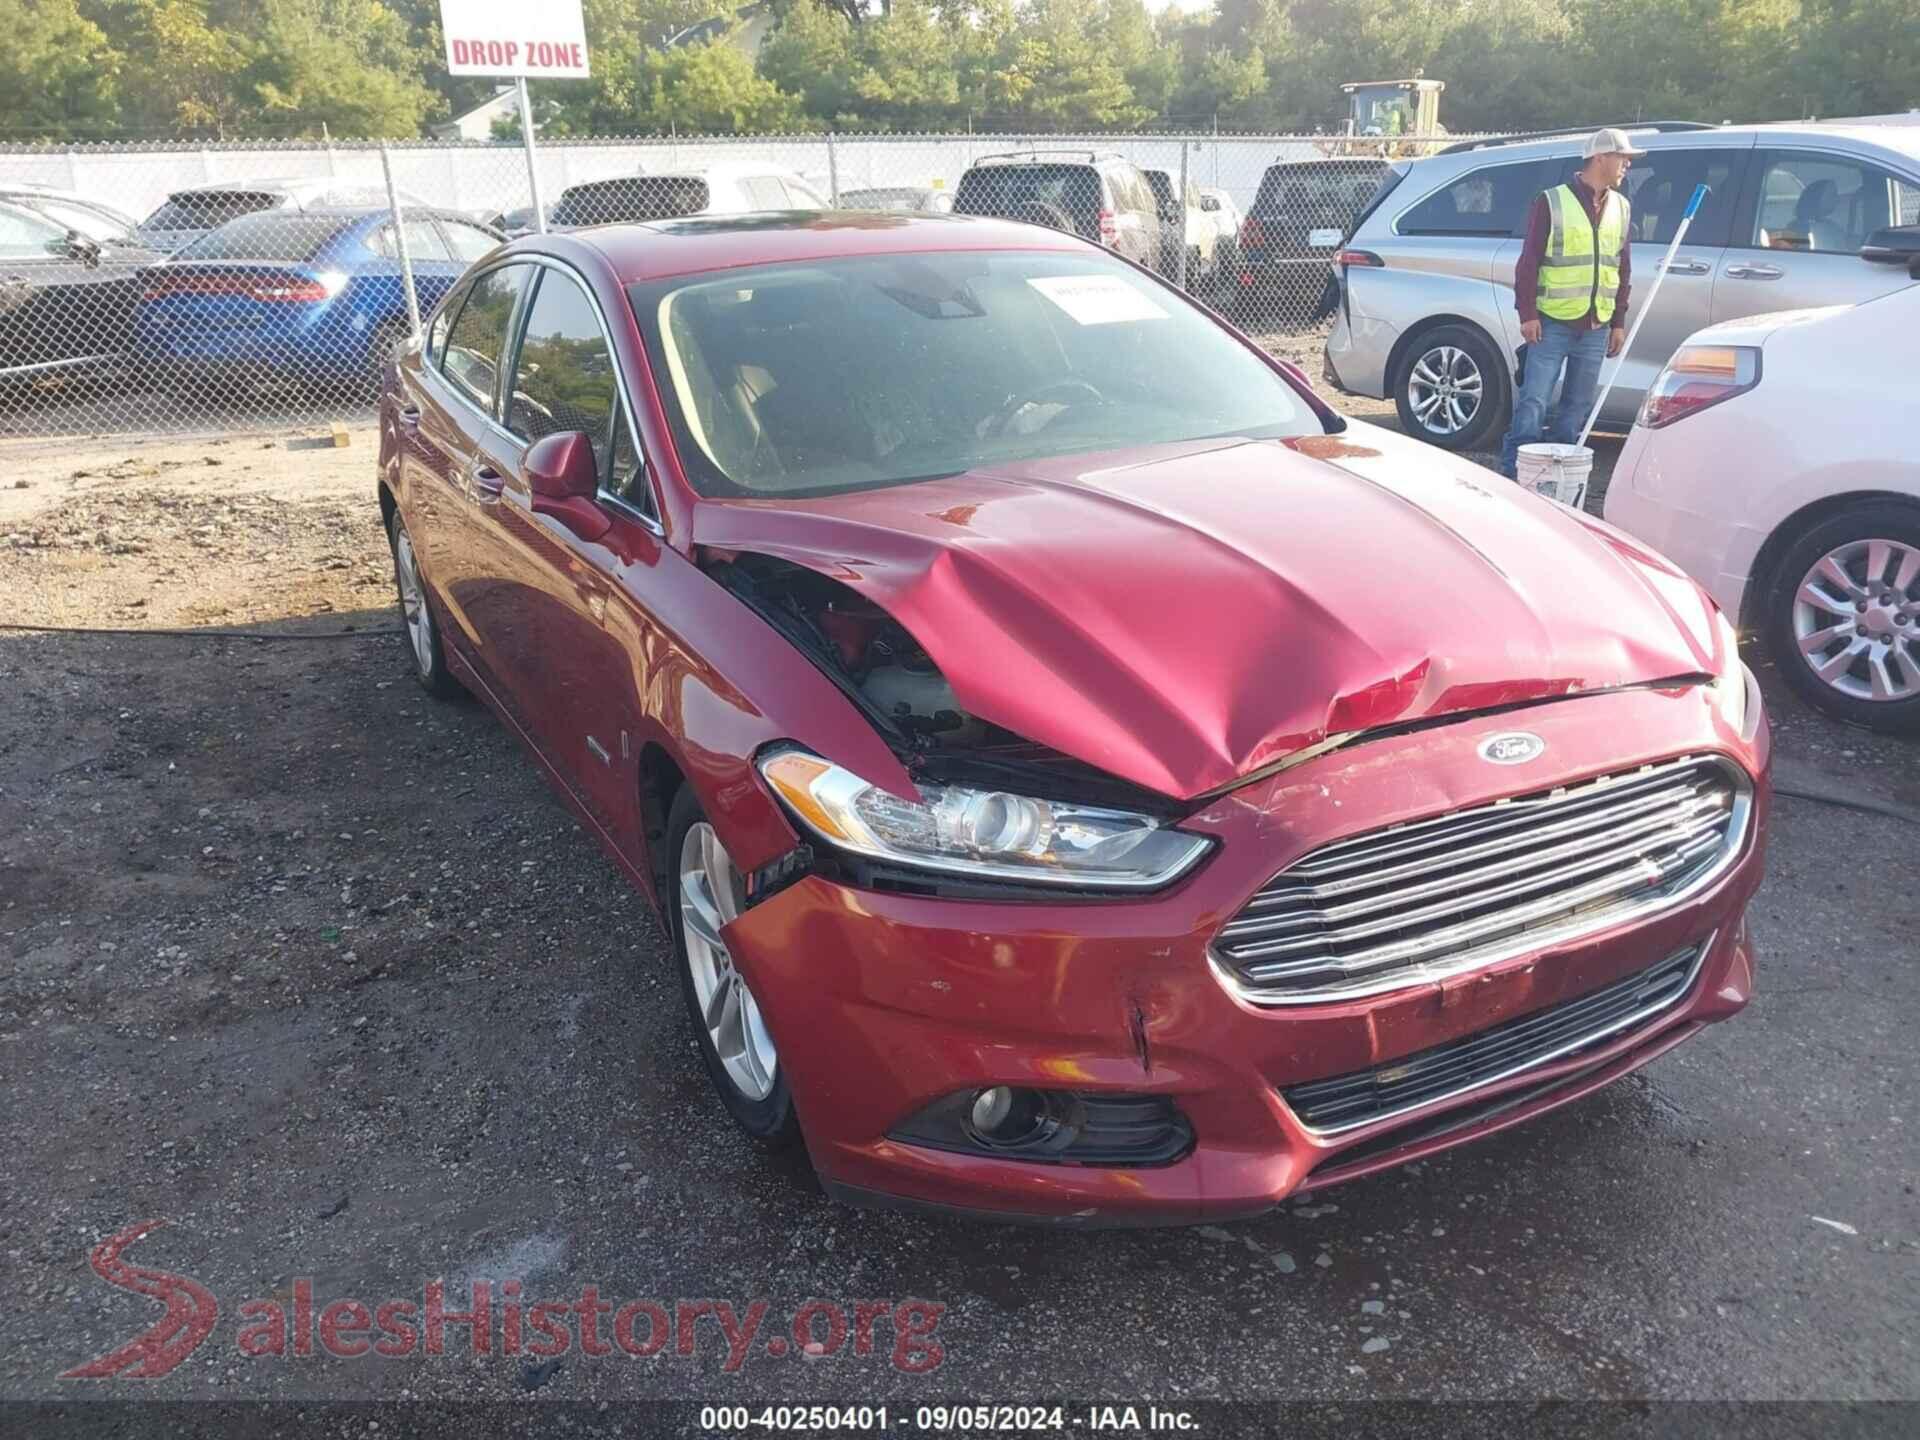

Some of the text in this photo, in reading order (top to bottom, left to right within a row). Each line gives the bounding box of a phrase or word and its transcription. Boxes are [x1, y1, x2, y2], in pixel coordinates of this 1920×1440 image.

[452, 39, 583, 68] DROP ZONE
[1492, 737, 1533, 760] Ford
